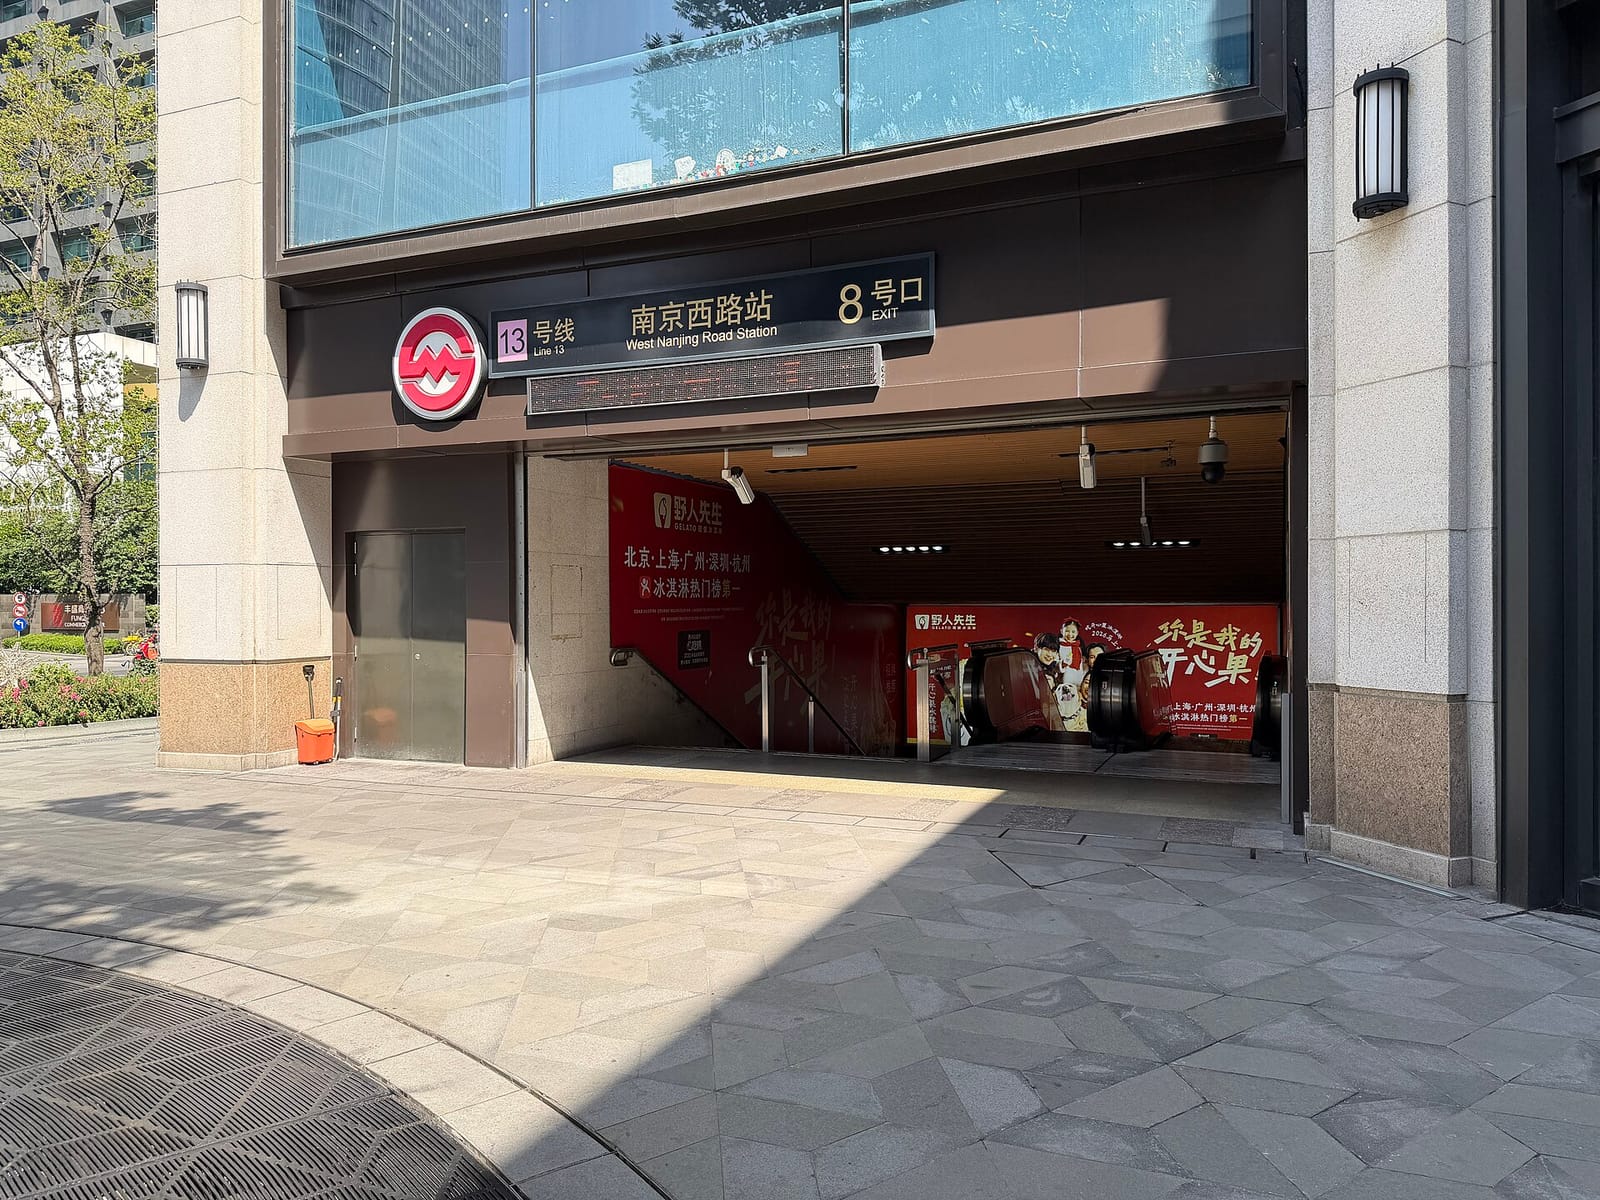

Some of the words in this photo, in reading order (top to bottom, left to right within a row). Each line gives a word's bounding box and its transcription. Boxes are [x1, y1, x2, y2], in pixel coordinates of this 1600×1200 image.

[631, 289, 773, 336] 南京西路站
[839, 283, 863, 324] 8
[871, 277, 922, 306] 号口
[872, 307, 899, 321] EXIT
[500, 328, 525, 354] 13
[533, 317, 575, 345] 号线
[626, 339, 654, 351] West
[657, 334, 699, 349] Nanjing
[702, 329, 733, 343] Road
[736, 325, 778, 340] Station
[534, 346, 552, 356] Line
[554, 344, 565, 354] 13
[674, 496, 722, 526] 野人先生
[674, 522, 697, 533] GELATO
[17, 594, 23, 602] 5
[653, 576, 741, 599] 冰淇淋热门榜第一
[931, 614, 976, 626] 野人先生
[1154, 618, 1263, 658] 你是我的
